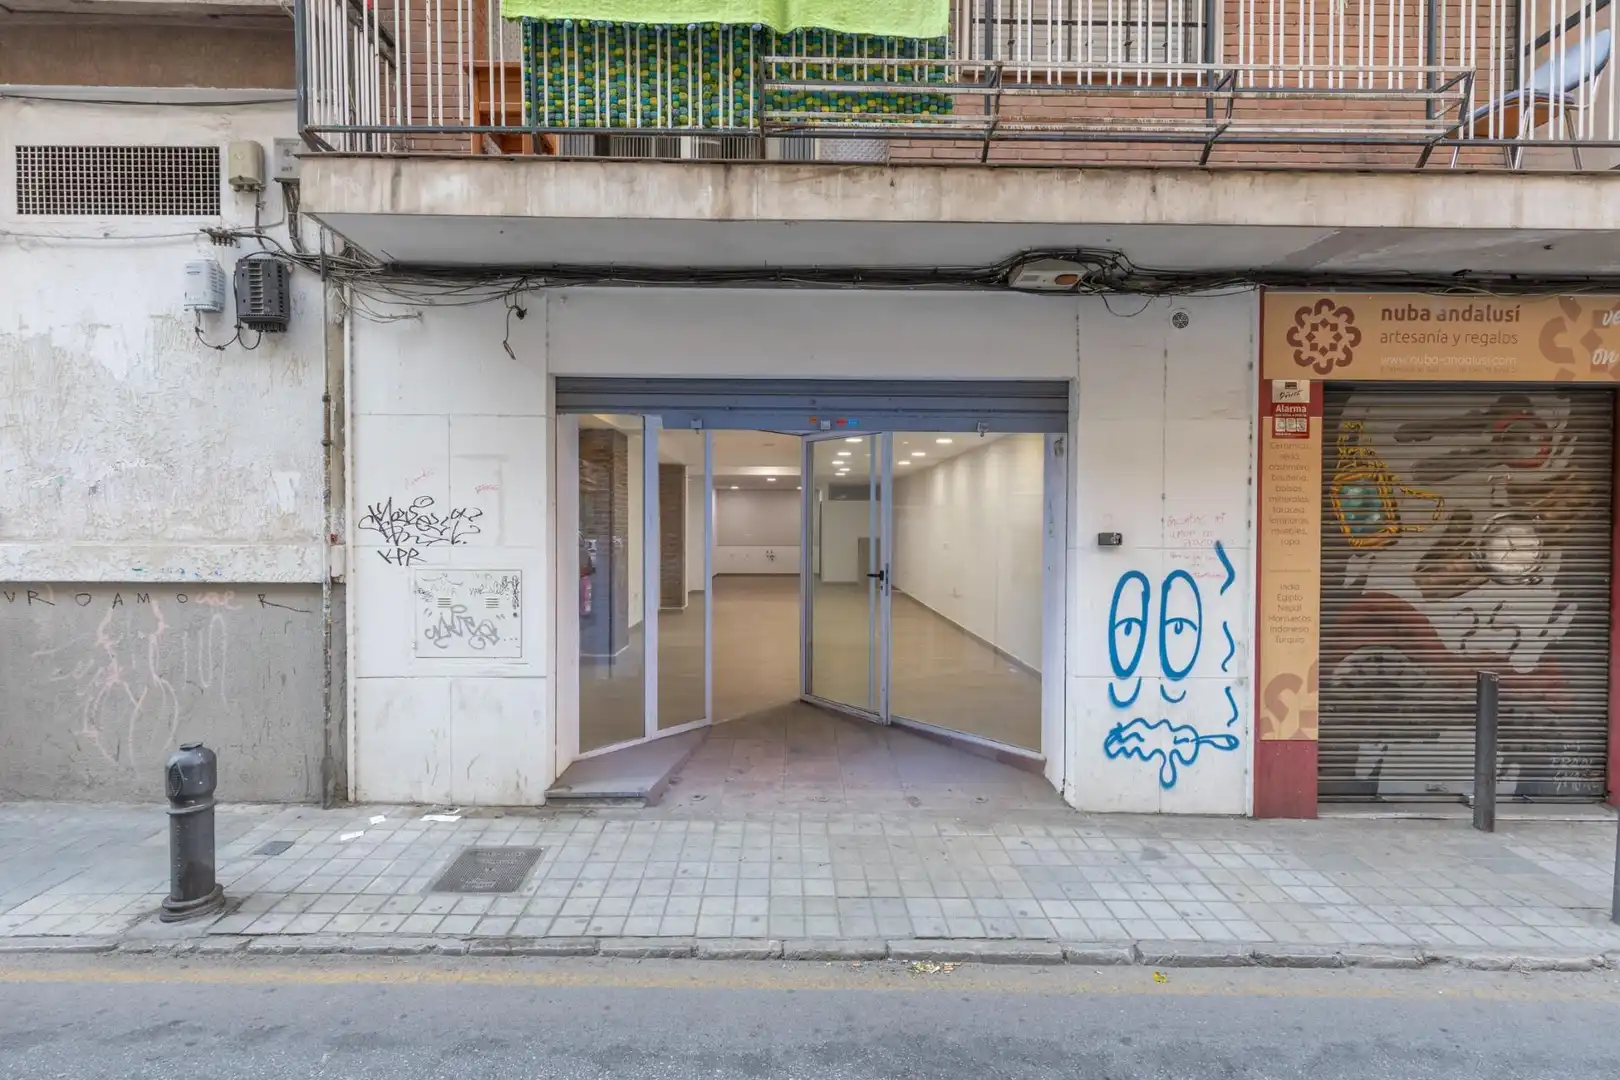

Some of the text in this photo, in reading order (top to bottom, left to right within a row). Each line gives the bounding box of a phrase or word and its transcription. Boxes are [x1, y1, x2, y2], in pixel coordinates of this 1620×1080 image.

[1381, 303, 1521, 322] nuba andalusí
[1380, 329, 1518, 347] artesanía y regalos
[1275, 403, 1307, 413] Alarma
[1276, 593, 1304, 603] Egipto
